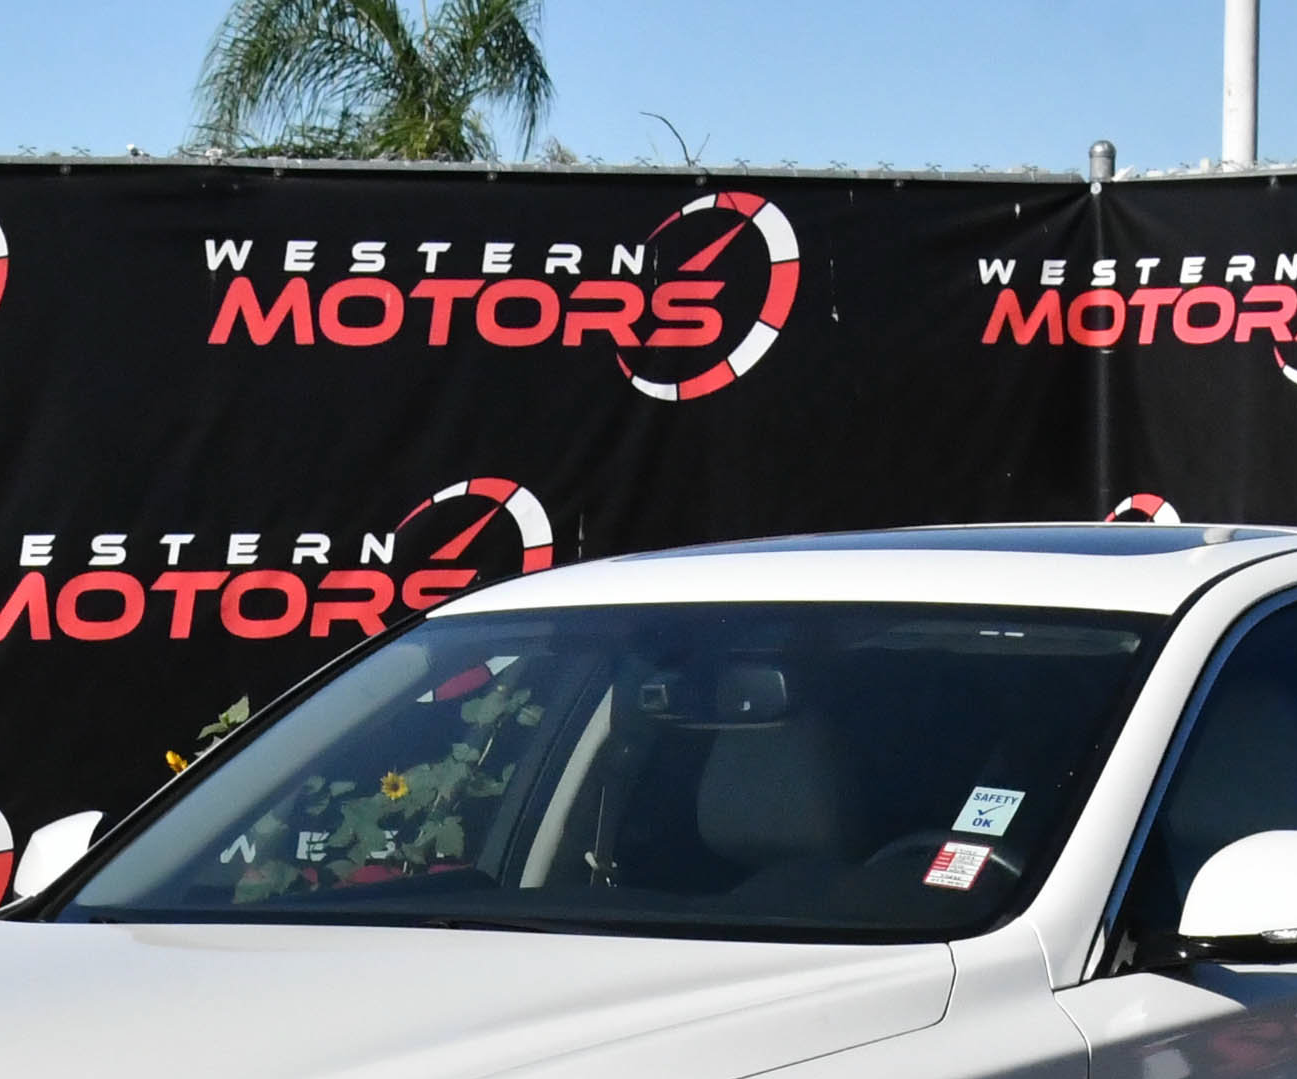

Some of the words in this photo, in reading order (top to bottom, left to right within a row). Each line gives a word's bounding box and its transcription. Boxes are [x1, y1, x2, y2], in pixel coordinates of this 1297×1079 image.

[206, 240, 644, 274] WESTERN
[209, 277, 725, 346] MOTORS
[973, 792, 1019, 806] SAFETY
[972, 817, 994, 828] OK
